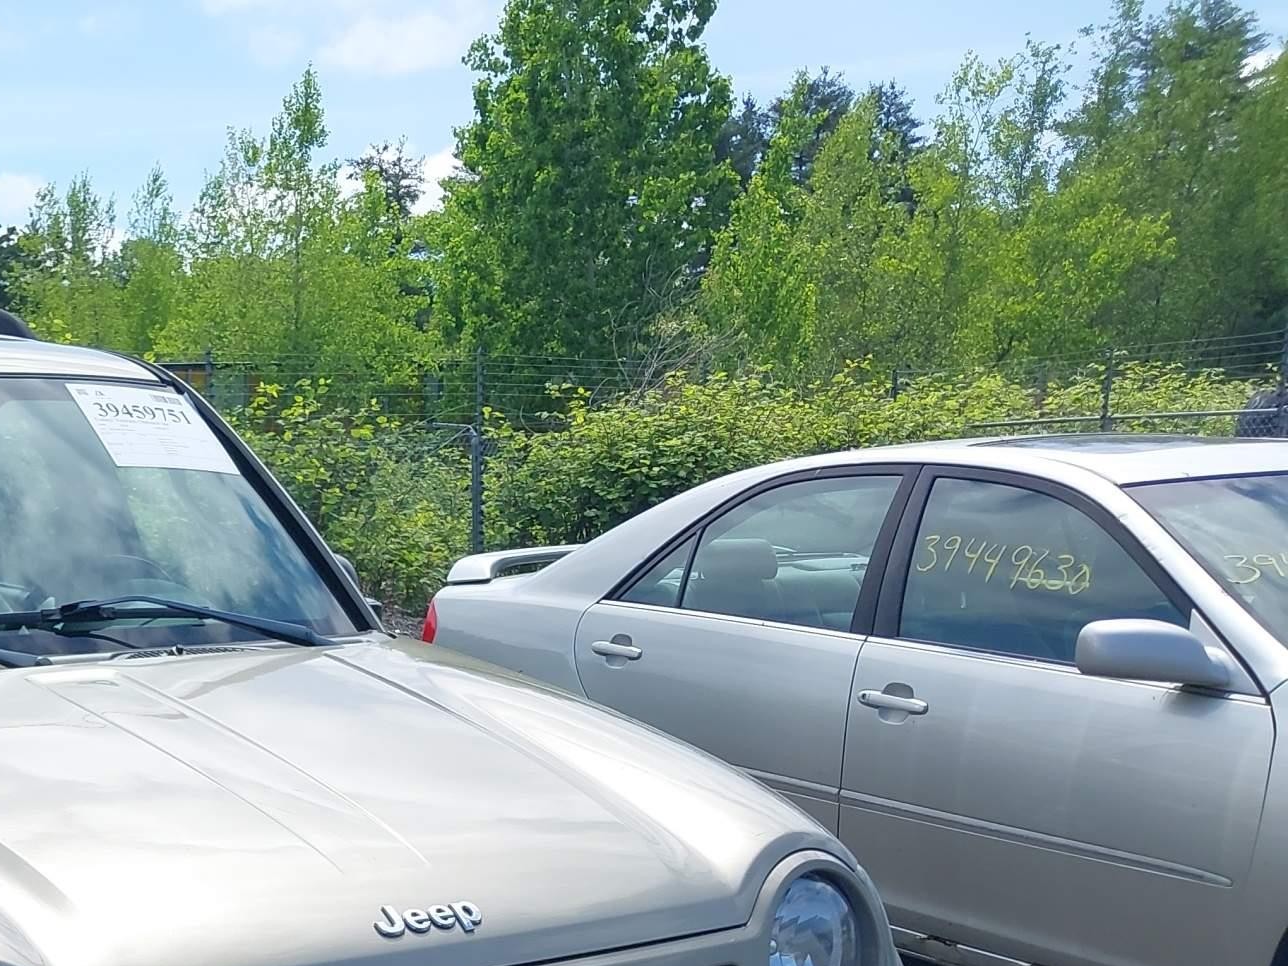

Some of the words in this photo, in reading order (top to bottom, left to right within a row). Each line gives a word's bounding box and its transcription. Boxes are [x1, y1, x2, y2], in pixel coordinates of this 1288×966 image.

[93, 402, 191, 424] 39459751
[916, 535, 1091, 595] 39449630
[373, 901, 482, 938] Jeep
